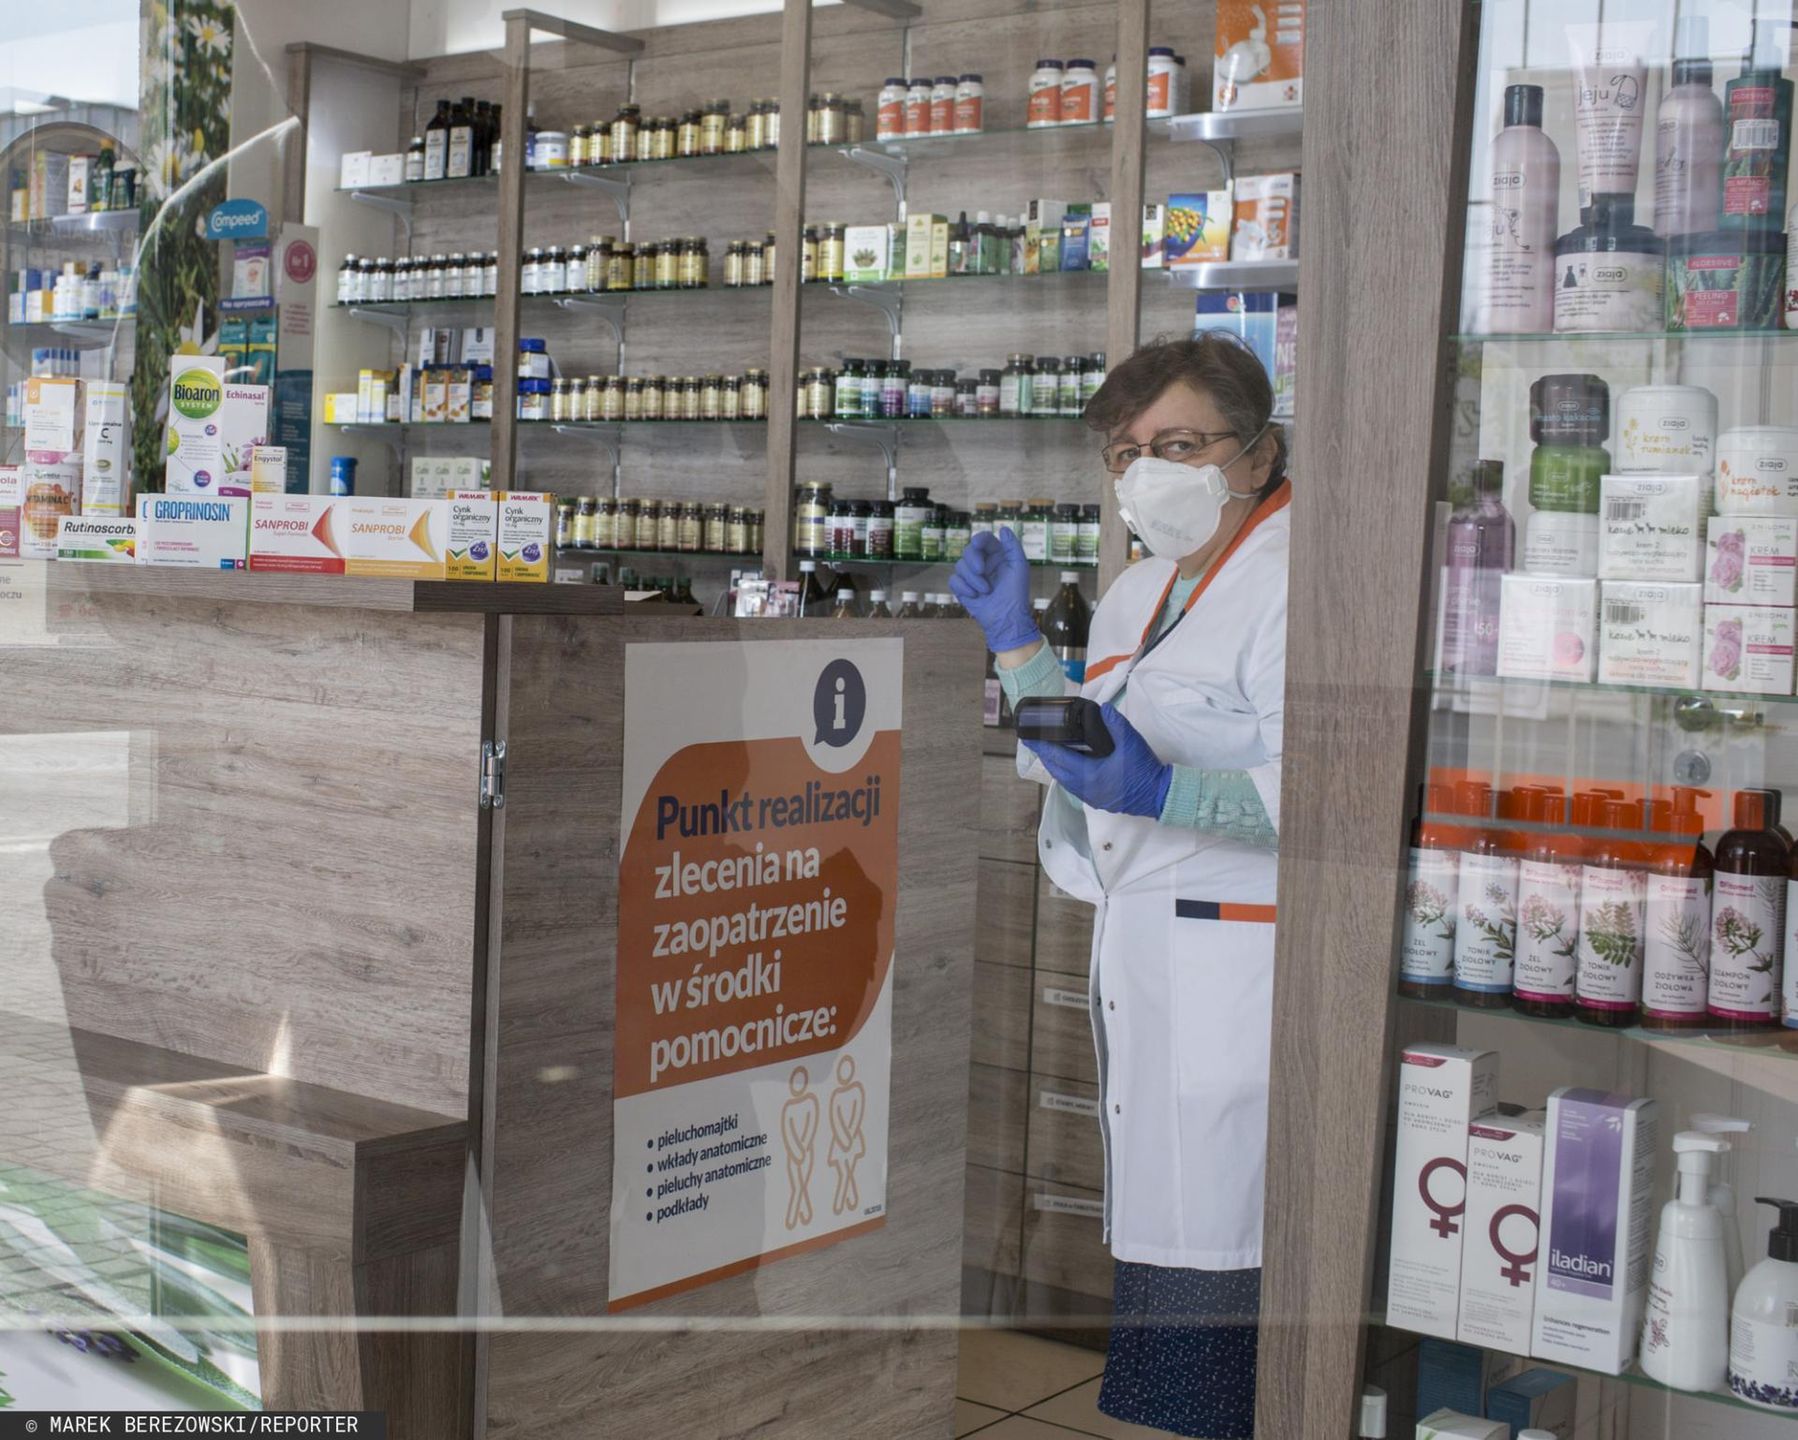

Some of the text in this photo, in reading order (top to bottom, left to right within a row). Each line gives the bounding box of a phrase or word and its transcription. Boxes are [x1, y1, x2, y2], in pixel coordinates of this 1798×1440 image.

[1578, 83, 1609, 106] jeju
[211, 209, 260, 233] Compeed
[1597, 270, 1623, 280] ziaja
[174, 384, 220, 401] Bioaron
[226, 390, 265, 400] Echinasal
[180, 401, 212, 409] SYSTEM
[1662, 419, 1686, 429] ziaja
[100, 428, 110, 439] C
[1643, 432, 1671, 442] krem
[253, 455, 283, 464] Engystol
[1759, 460, 1784, 470] ziaja
[1637, 484, 1663, 492] ziaja
[155, 500, 231, 522] GROPRINOSIN
[453, 505, 471, 514] Cynk
[505, 507, 524, 516] Cynk
[453, 513, 491, 523] organiczny
[505, 515, 543, 525] organiczny
[255, 519, 309, 531] SANPROBI
[352, 522, 406, 534] SANPROBI
[1751, 546, 1779, 555] KREM
[1639, 591, 1664, 600] ziaja
[1748, 635, 1776, 644] KREM
[657, 775, 881, 840] Punkt realizacji
[654, 841, 820, 899] zlecenia na
[652, 887, 848, 957] zaopatrzenie
[651, 949, 782, 1015] w środki
[1654, 970, 1695, 982] ODŻYWKA
[1655, 982, 1694, 993] ZIOŁOWA
[651, 1003, 837, 1083] pomocnicze:
[1404, 1083, 1450, 1099] PROVAG
[658, 1113, 739, 1151] pieluchomajtki
[657, 1132, 768, 1172] wkłady anatomiczne
[1474, 1147, 1519, 1163] PROVAG
[657, 1154, 772, 1200] pieluchy anatomiczne
[657, 1194, 710, 1223] podkłady
[1551, 1248, 1611, 1278] iladian
[1543, 1315, 1611, 1335] Enhances regeneration
